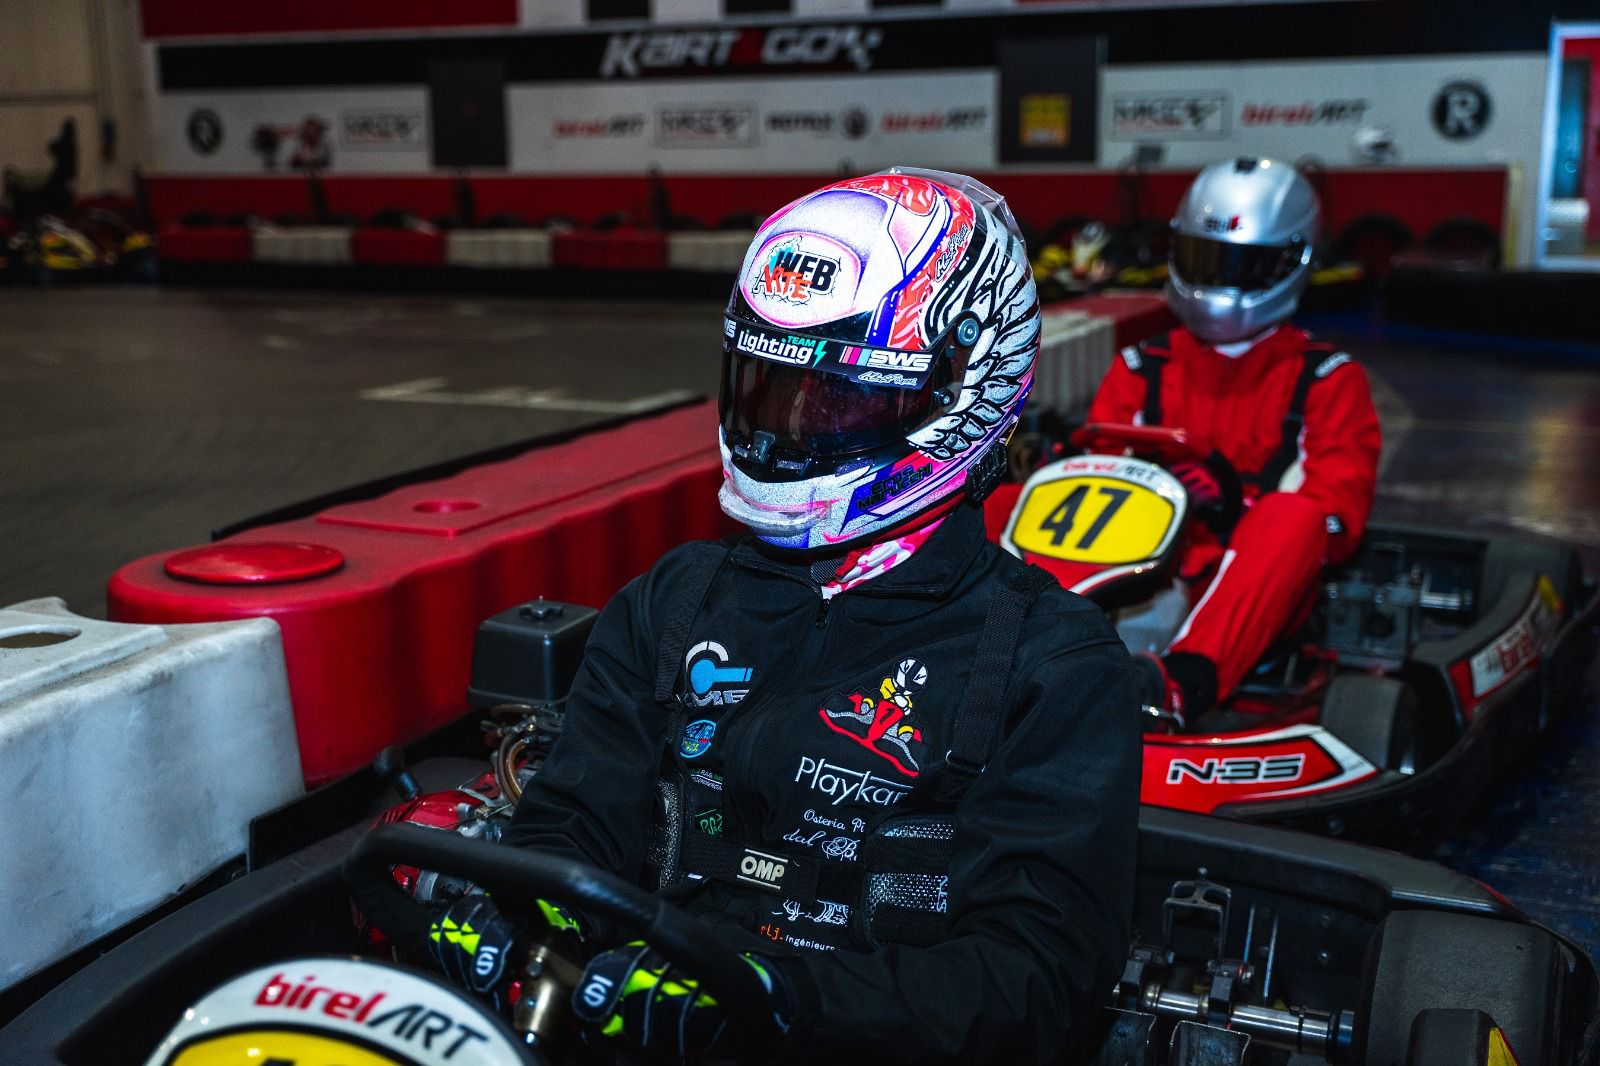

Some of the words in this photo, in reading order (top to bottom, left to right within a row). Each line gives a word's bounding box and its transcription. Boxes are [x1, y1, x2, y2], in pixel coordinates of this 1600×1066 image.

[775, 251, 837, 291] WEB
[737, 329, 814, 365] Lighting
[787, 335, 816, 346] TEAM
[867, 349, 933, 372] SWS
[1039, 484, 1133, 550] 47
[804, 808, 846, 830] Osteria
[740, 855, 785, 882] OMP
